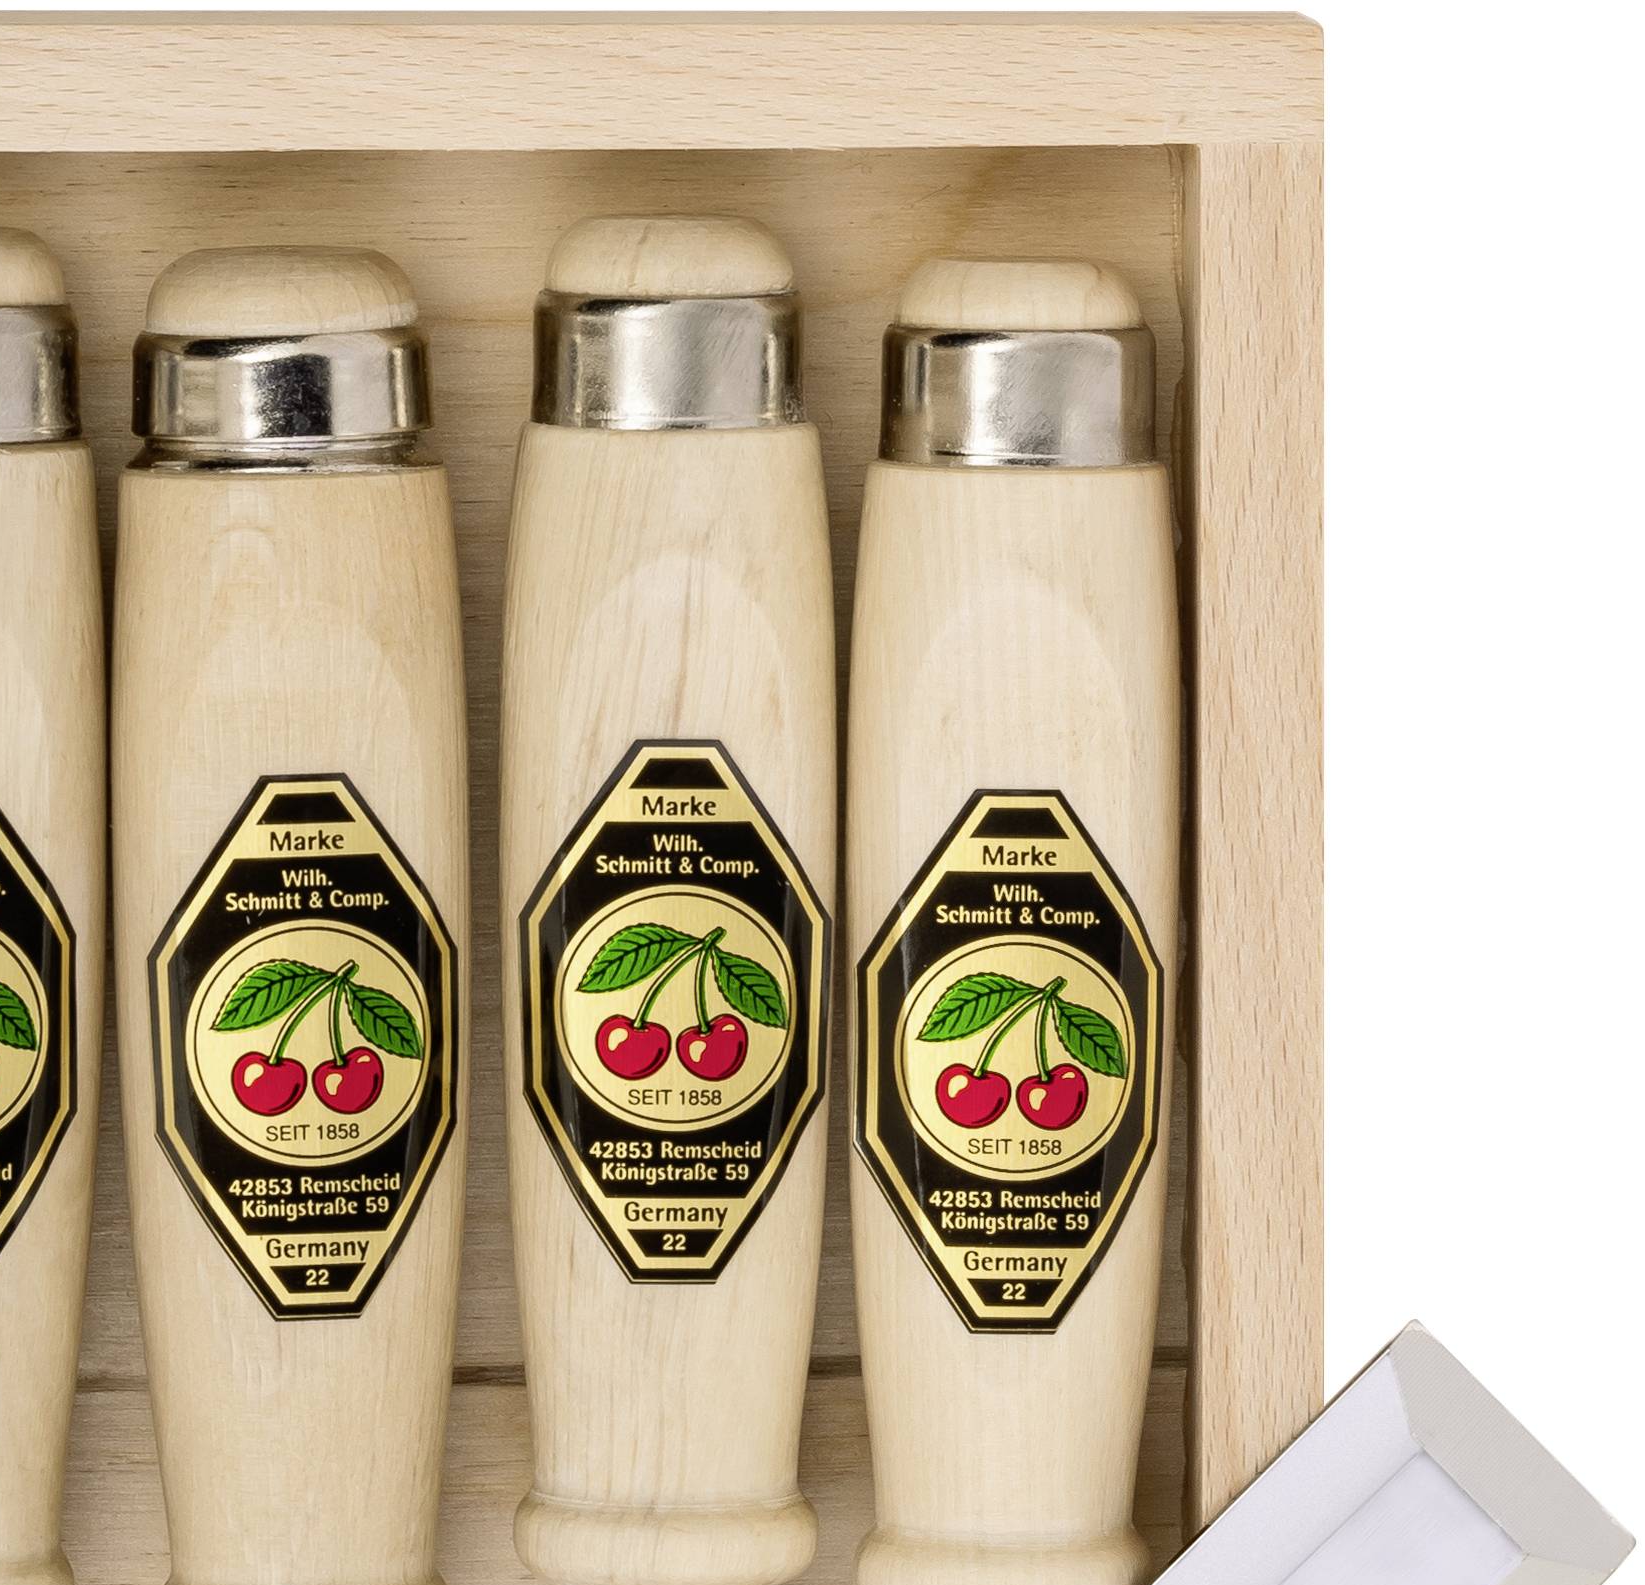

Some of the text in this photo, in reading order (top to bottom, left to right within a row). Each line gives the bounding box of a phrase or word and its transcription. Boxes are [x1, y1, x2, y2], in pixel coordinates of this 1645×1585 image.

[642, 795, 717, 817] Marke
[270, 829, 345, 852] Marke
[653, 834, 704, 852] Wilh.
[595, 854, 760, 878] Schmitt & Comp.
[982, 845, 1057, 867] Marke
[281, 868, 333, 888] Wilh.
[225, 889, 389, 912] Schmitt & Comp.
[993, 884, 1044, 903] Wilh.
[936, 904, 1101, 929] Schmitt & Comp.
[628, 1088, 722, 1106] SEIT 1858
[265, 1122, 360, 1142] SEIT 1858
[588, 1140, 762, 1159] 42853 Remscheid
[968, 1138, 1062, 1156] SEIT 1858
[601, 1161, 749, 1185] Königstraße 59
[228, 1172, 401, 1197] 42853 Remscheid
[241, 1196, 390, 1222] Königstraße 59
[928, 1190, 1101, 1209] 42853 Remscheid
[624, 1201, 729, 1228] Germany
[941, 1210, 1089, 1235] Königstraße 59
[265, 1238, 370, 1262] Germany
[662, 1233, 686, 1251] 22
[963, 1250, 1068, 1278] Germany
[305, 1268, 330, 1286] 22
[1002, 1282, 1026, 1300] 22
